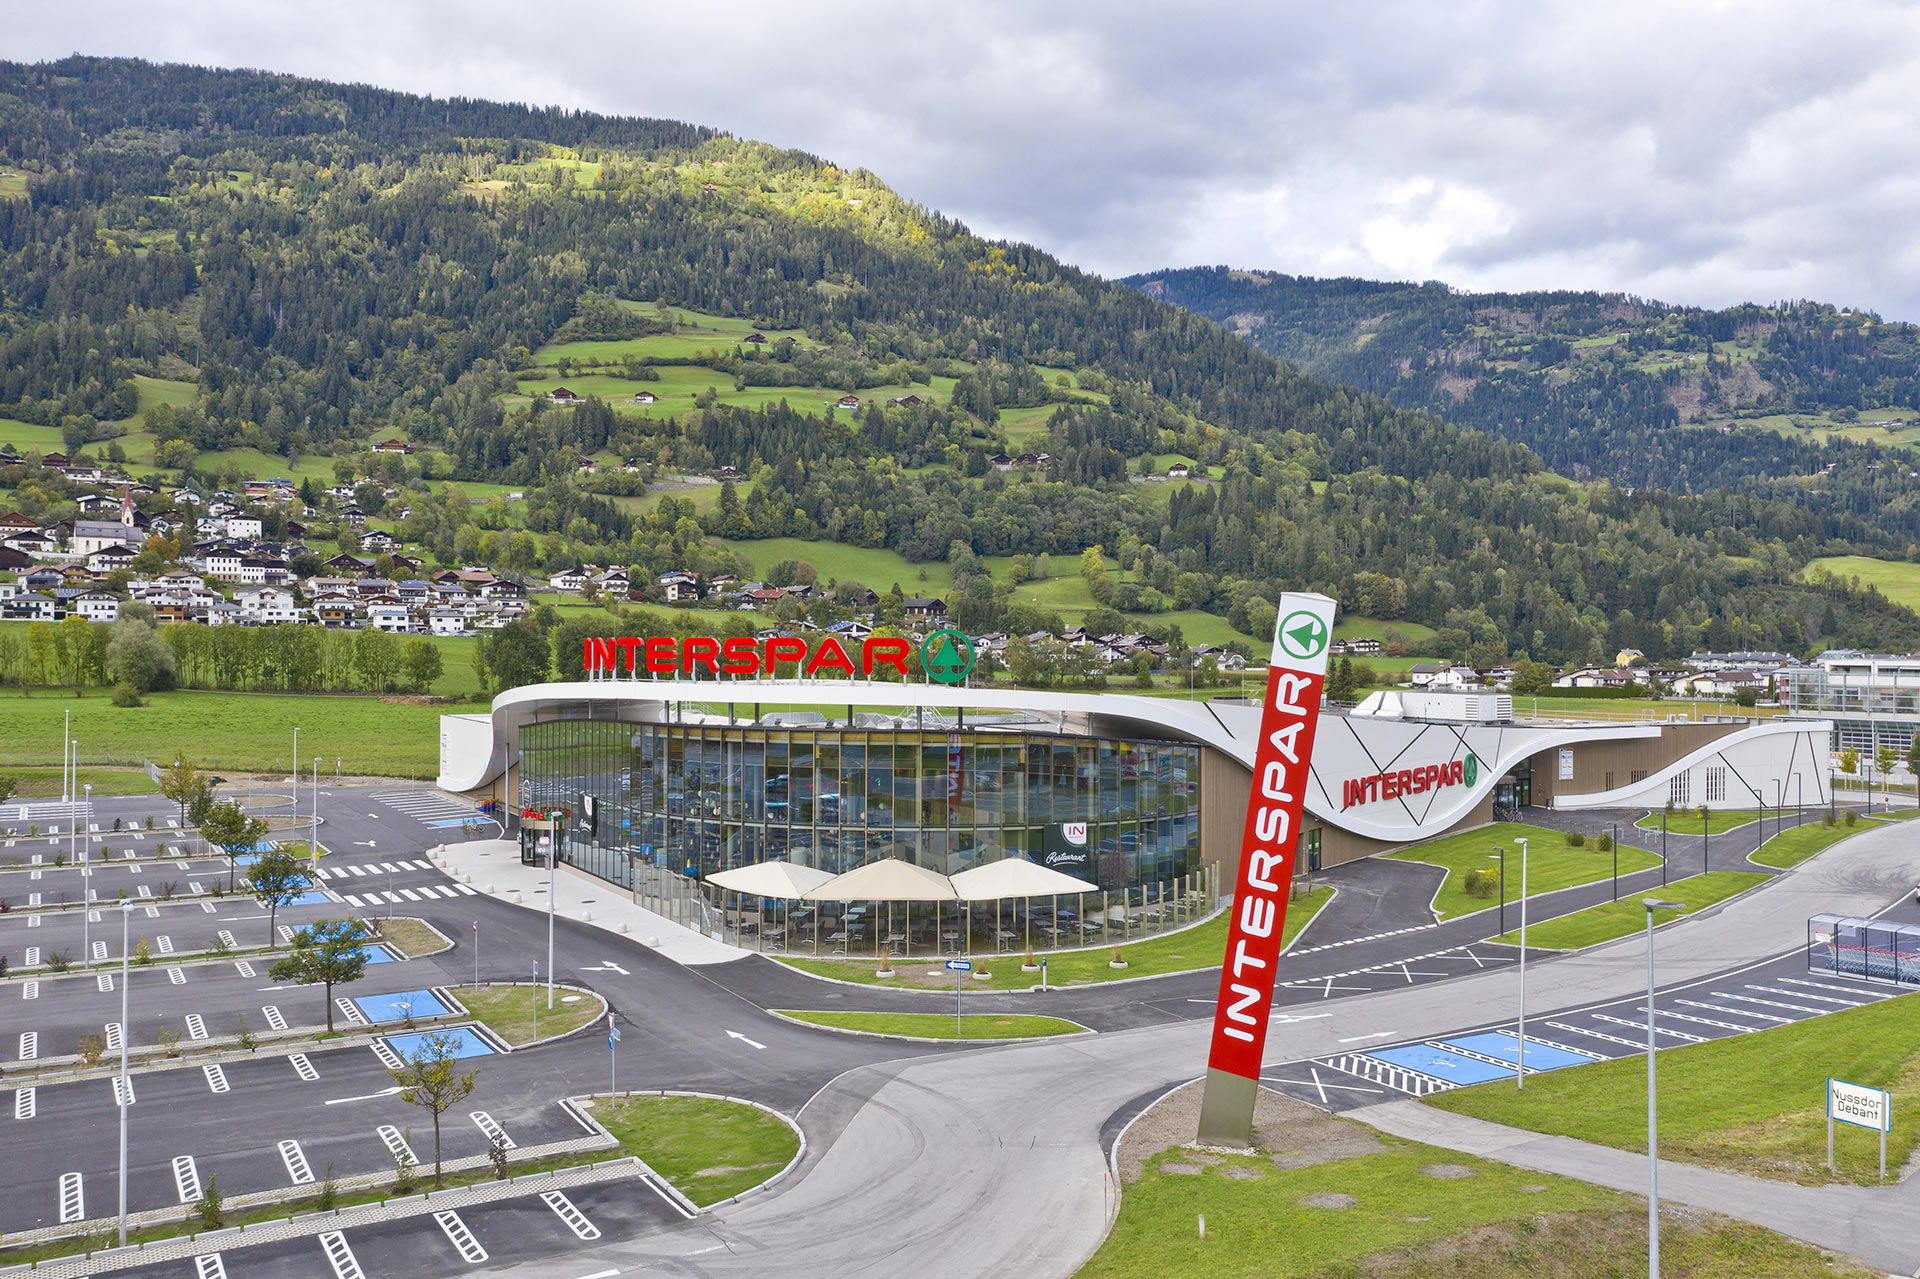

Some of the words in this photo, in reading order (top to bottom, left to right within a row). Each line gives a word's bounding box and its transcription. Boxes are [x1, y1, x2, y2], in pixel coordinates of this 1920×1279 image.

[583, 636, 910, 676] INTERSPAR
[1344, 760, 1463, 809] INTERSPAR
[1068, 825, 1085, 836] IN
[1045, 851, 1087, 864] Restaurant
[1224, 673, 1312, 1042] INTERSPAR
[1832, 1088, 1882, 1109] Nussdor
[1838, 1101, 1879, 1120] Debant
